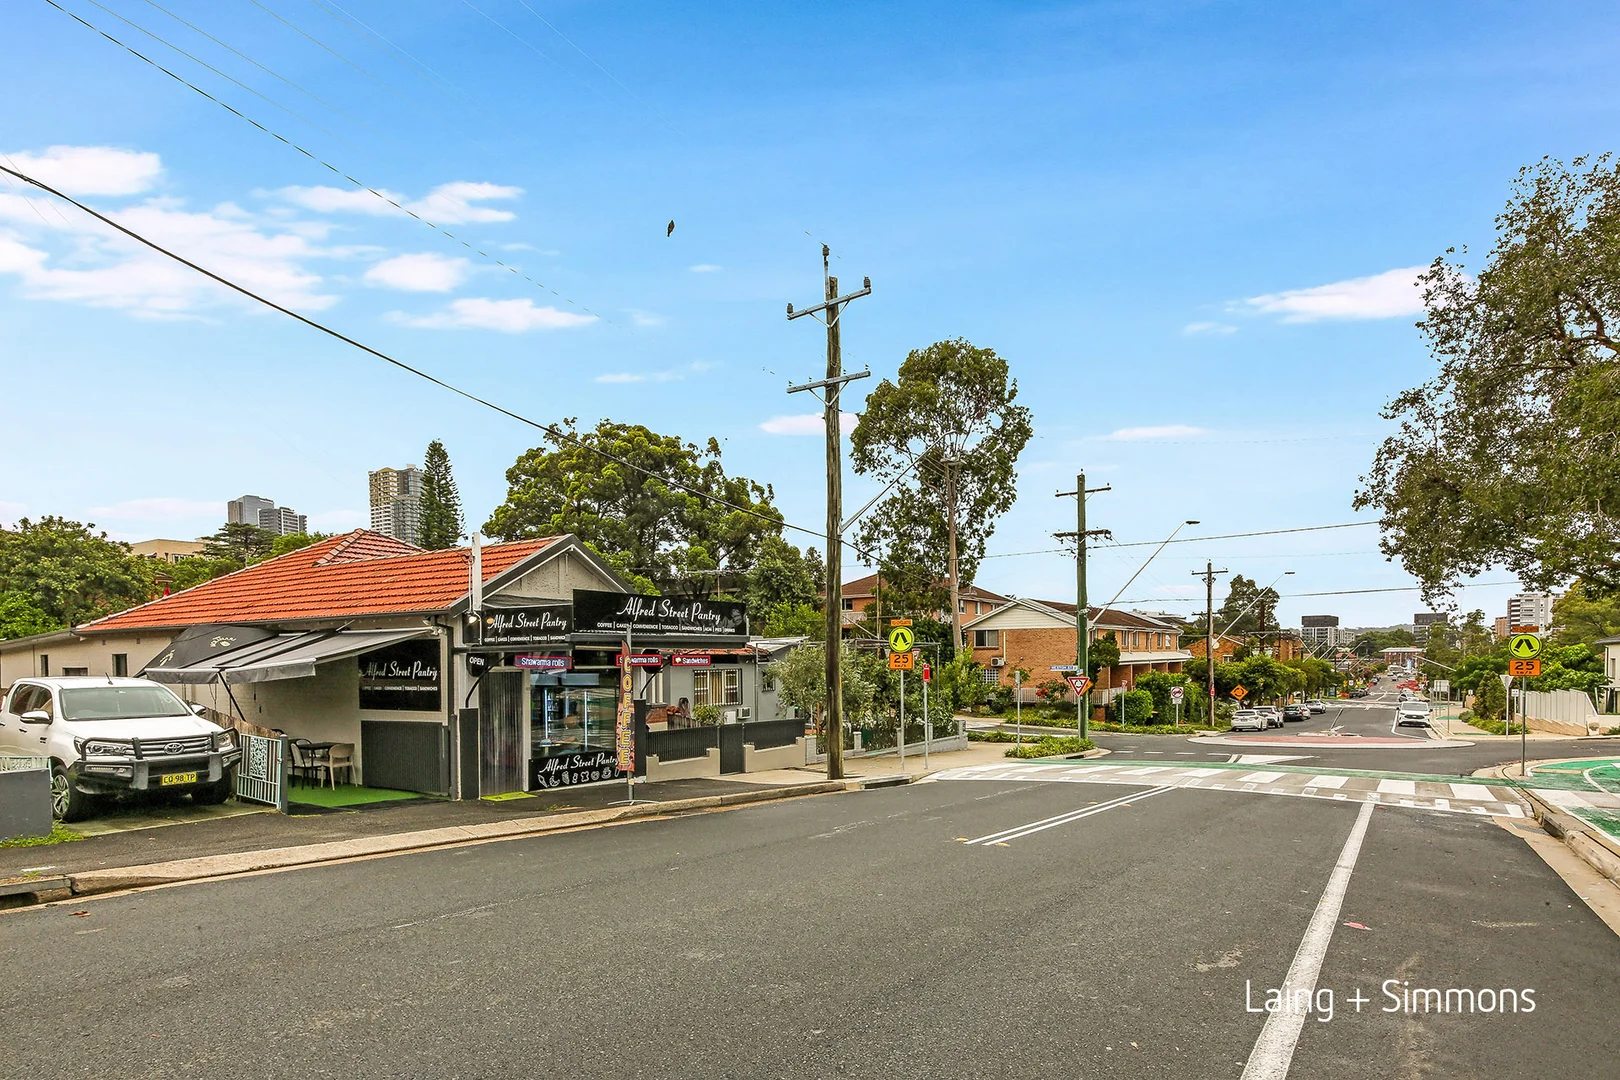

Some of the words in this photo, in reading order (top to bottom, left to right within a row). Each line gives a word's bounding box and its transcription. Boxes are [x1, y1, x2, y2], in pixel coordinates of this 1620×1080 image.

[616, 597, 656, 621] Alfred
[658, 599, 689, 618] Street
[690, 602, 721, 625] Pantry
[487, 614, 515, 633] Alfred
[515, 612, 540, 628] Street
[540, 611, 567, 631] Pantry
[469, 656, 485, 666] OPEN
[552, 659, 565, 667] rolls
[894, 654, 909, 663] 25
[1514, 661, 1535, 671] 25
[362, 662, 387, 680] Alfred
[388, 660, 411, 677] Street
[412, 660, 438, 681] Pantry
[620, 655, 633, 766] COFFEE
[539, 758, 570, 775] Alfred
[570, 755, 595, 769] Street
[175, 775, 184, 783] 98
